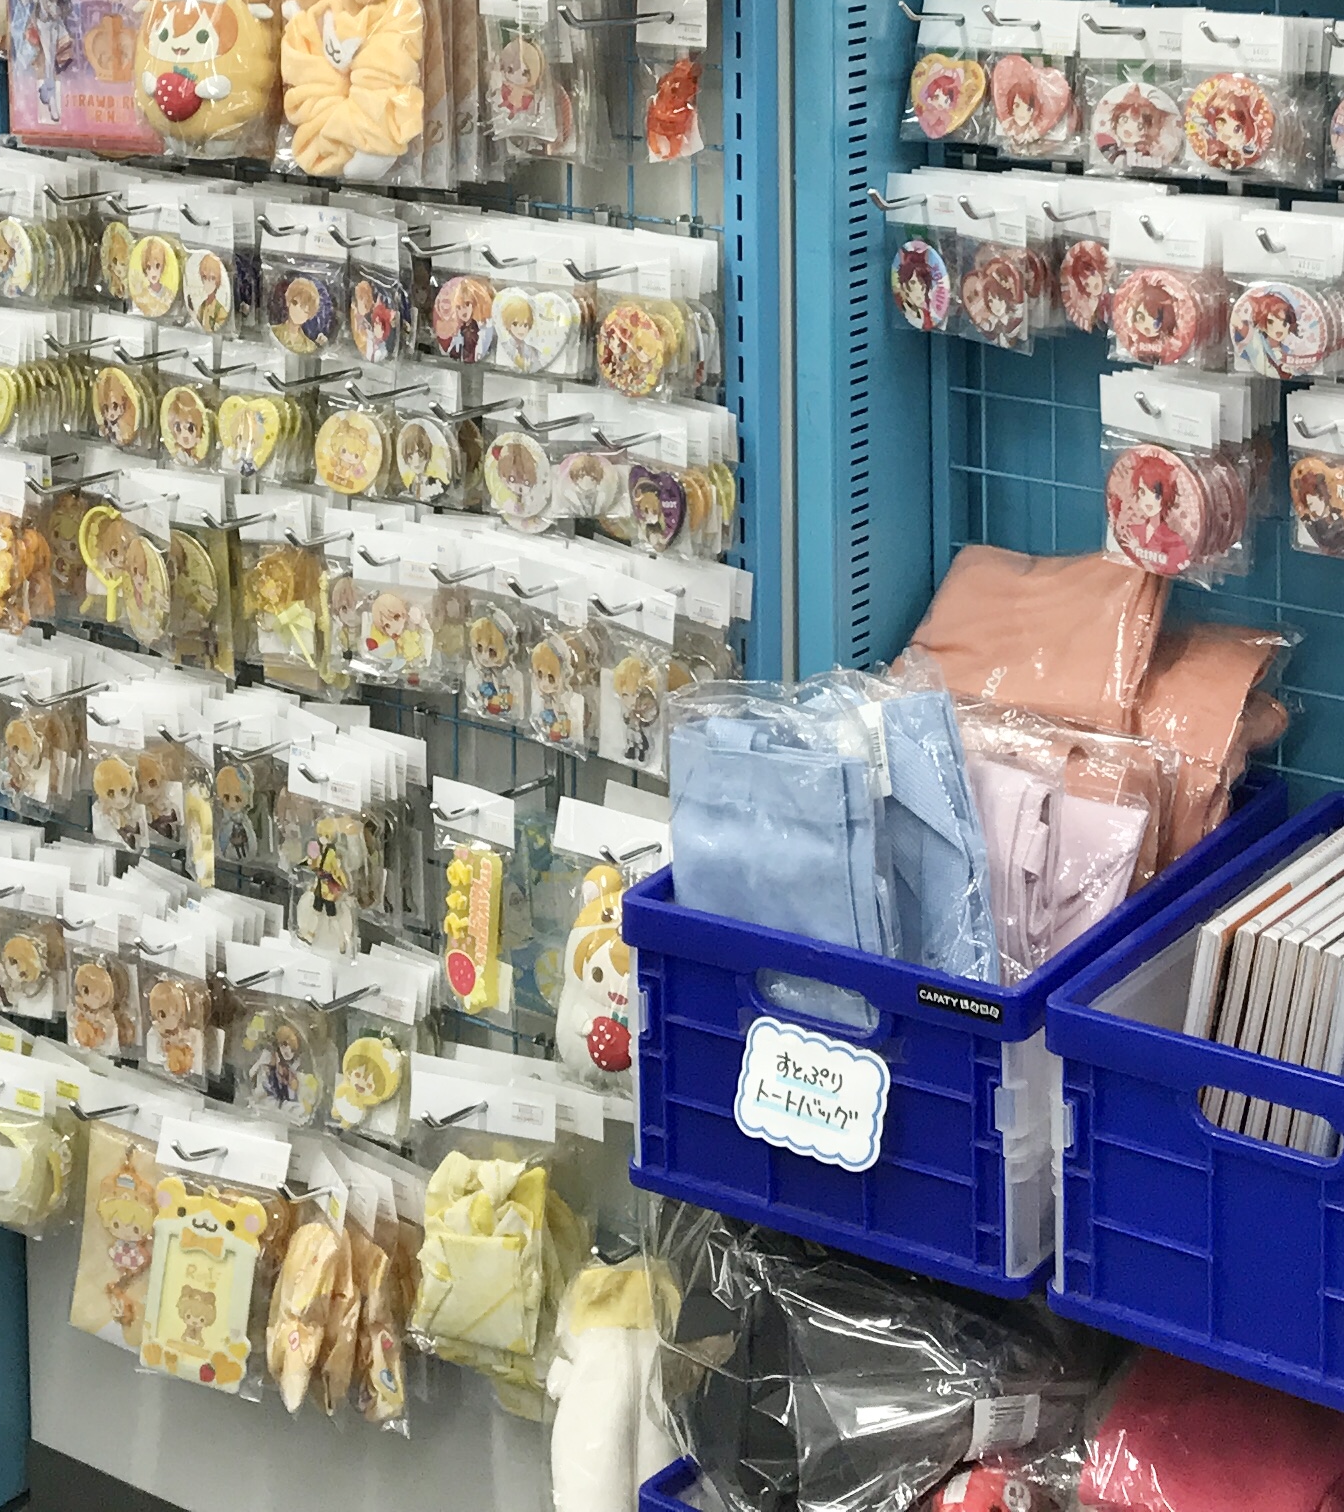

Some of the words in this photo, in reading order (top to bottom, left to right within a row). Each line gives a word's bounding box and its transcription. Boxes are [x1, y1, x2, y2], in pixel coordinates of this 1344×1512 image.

[918, 987, 960, 1009] CAPATY
[959, 997, 1002, 1020] LAND
[775, 1051, 844, 1094] すとぷり
[754, 1078, 859, 1130] トートバッグ
